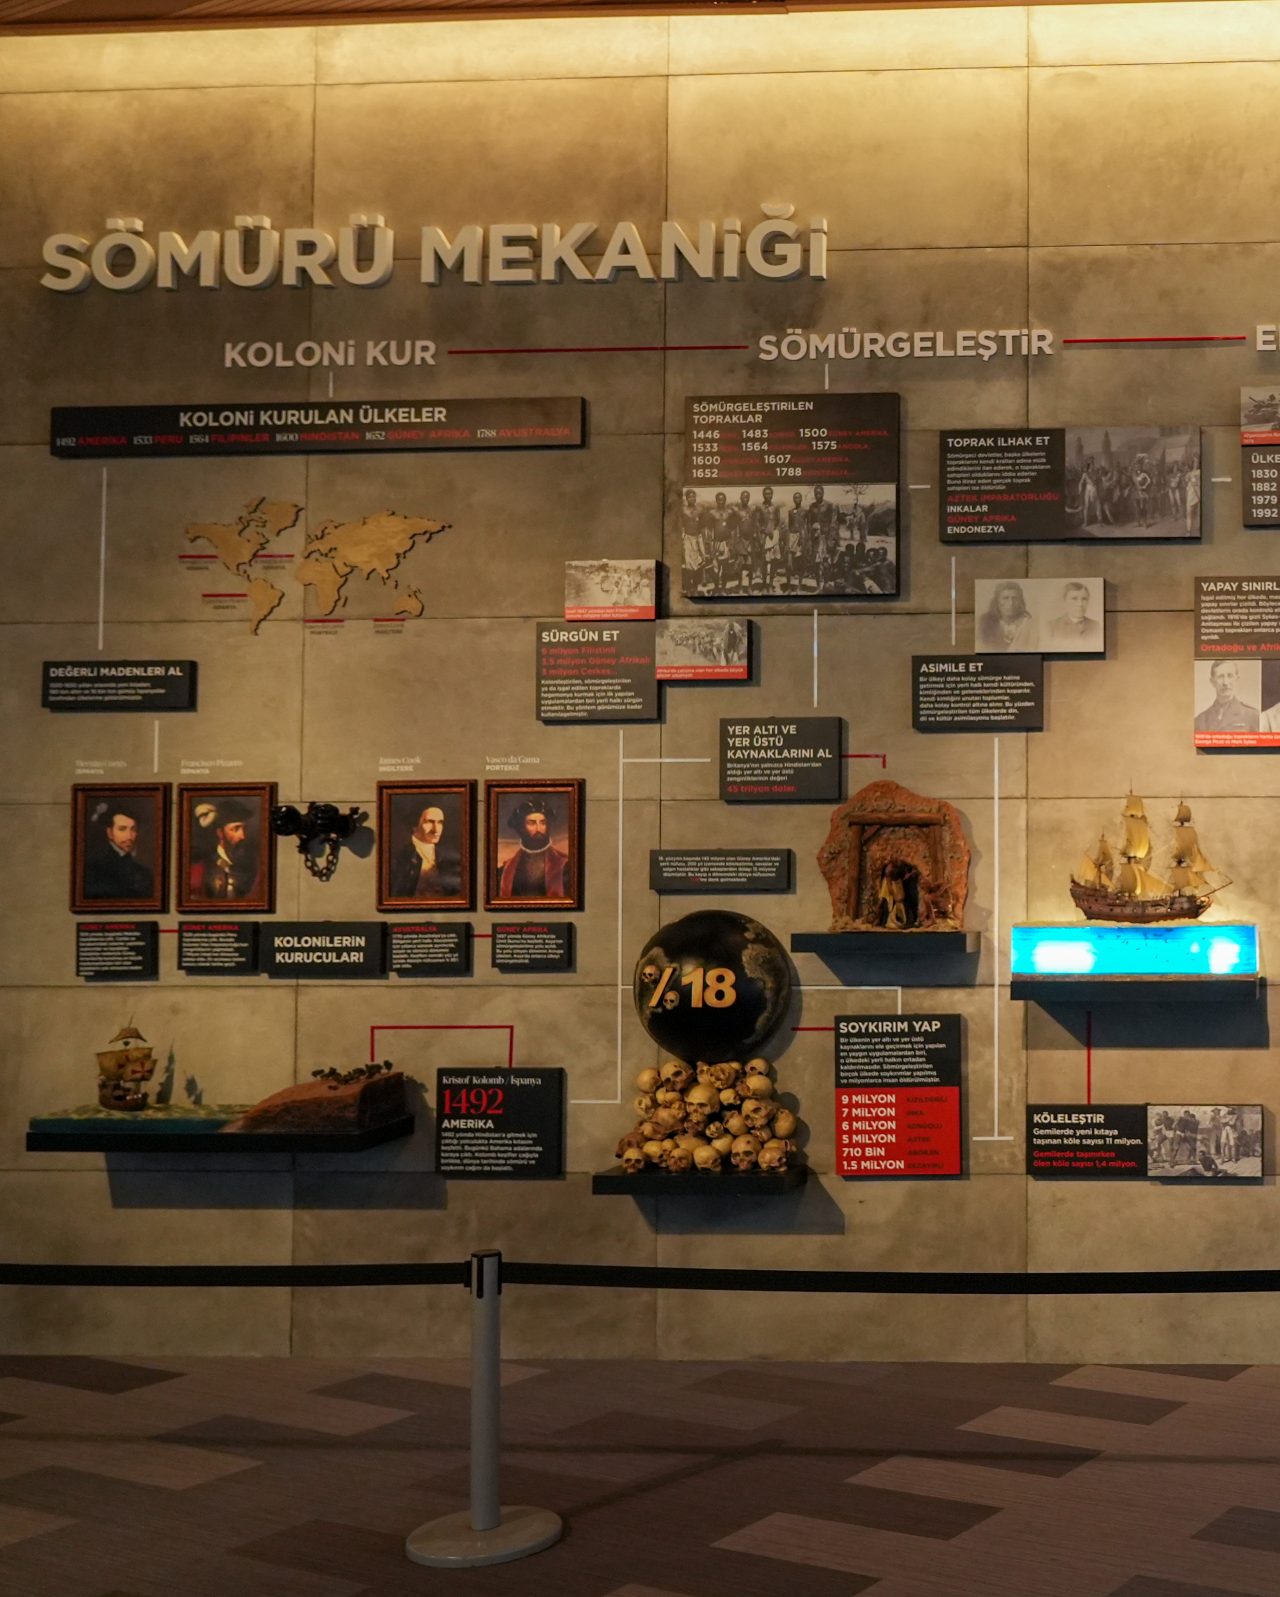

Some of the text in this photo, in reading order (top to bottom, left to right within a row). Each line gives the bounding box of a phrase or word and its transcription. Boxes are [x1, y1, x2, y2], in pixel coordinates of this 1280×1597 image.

[40, 213, 393, 291] SÖMÜRÜ
[366, 340, 436, 366] KUR
[260, 408, 353, 426] KURULAN
[359, 405, 447, 424] ÜLKELER
[693, 414, 763, 424] TOPRAKLAR
[693, 430, 720, 439] 1446
[742, 429, 769, 438] 1483
[799, 428, 828, 438] 1500
[693, 443, 718, 452] 1533
[947, 438, 995, 448] TOPRAK
[1036, 437, 1050, 445] ET
[693, 456, 721, 465] 1600
[776, 467, 802, 477] 1788
[1251, 469, 1278, 479] 1830
[1252, 509, 1279, 518] 1992
[947, 526, 1005, 534] ENDONEZYA
[1201, 582, 1239, 591] YAPAY
[542, 629, 620, 643] SÜRGÜN ET
[167, 666, 183, 676] AL
[969, 662, 984, 672] ET
[727, 725, 797, 735] YER ALTI VE
[727, 735, 783, 747] YER ÜSTÜ
[727, 749, 832, 759] KAYNAKLARINI AL
[275, 951, 364, 963] KURUCULARI
[640, 964, 737, 1010] %18
[839, 1020, 941, 1034] SOYKIRIM YAP
[442, 1087, 504, 1115] 1492
[841, 1095, 849, 1104] 9
[1033, 1127, 1074, 1136] Gemilerde
[1075, 1128, 1092, 1137] yeni
[1063, 1137, 1080, 1145] köle
[1114, 1137, 1143, 1146] milyon.
[842, 1147, 862, 1157] 710
[843, 1160, 857, 1170] 1.5
